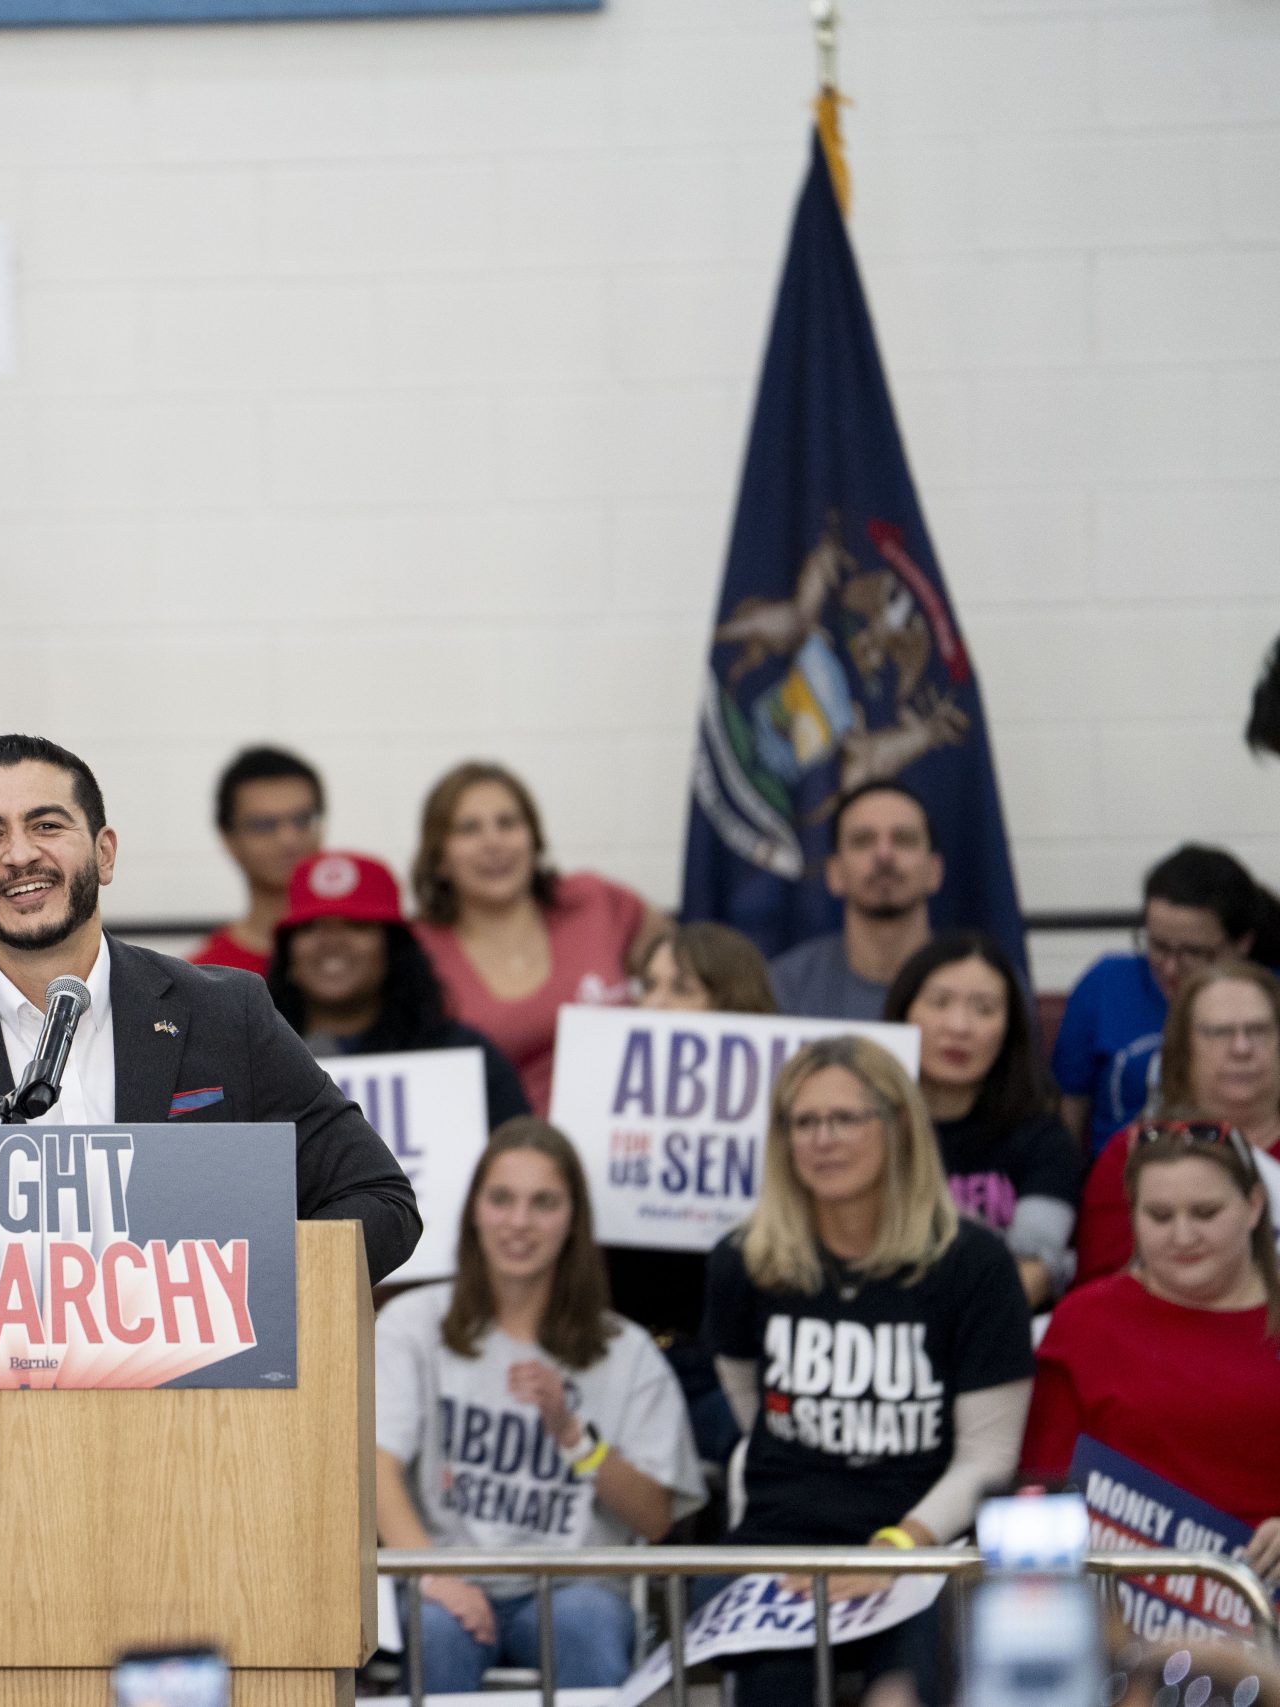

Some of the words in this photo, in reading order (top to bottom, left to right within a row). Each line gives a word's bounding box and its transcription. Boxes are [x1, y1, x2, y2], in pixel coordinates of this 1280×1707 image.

[659, 1131, 757, 1198] SEN
[10, 1355, 59, 1370] Bernie
[764, 1313, 945, 1401] ABDUL
[792, 1396, 944, 1456] SENATE
[1087, 1470, 1174, 1541] MONEY
